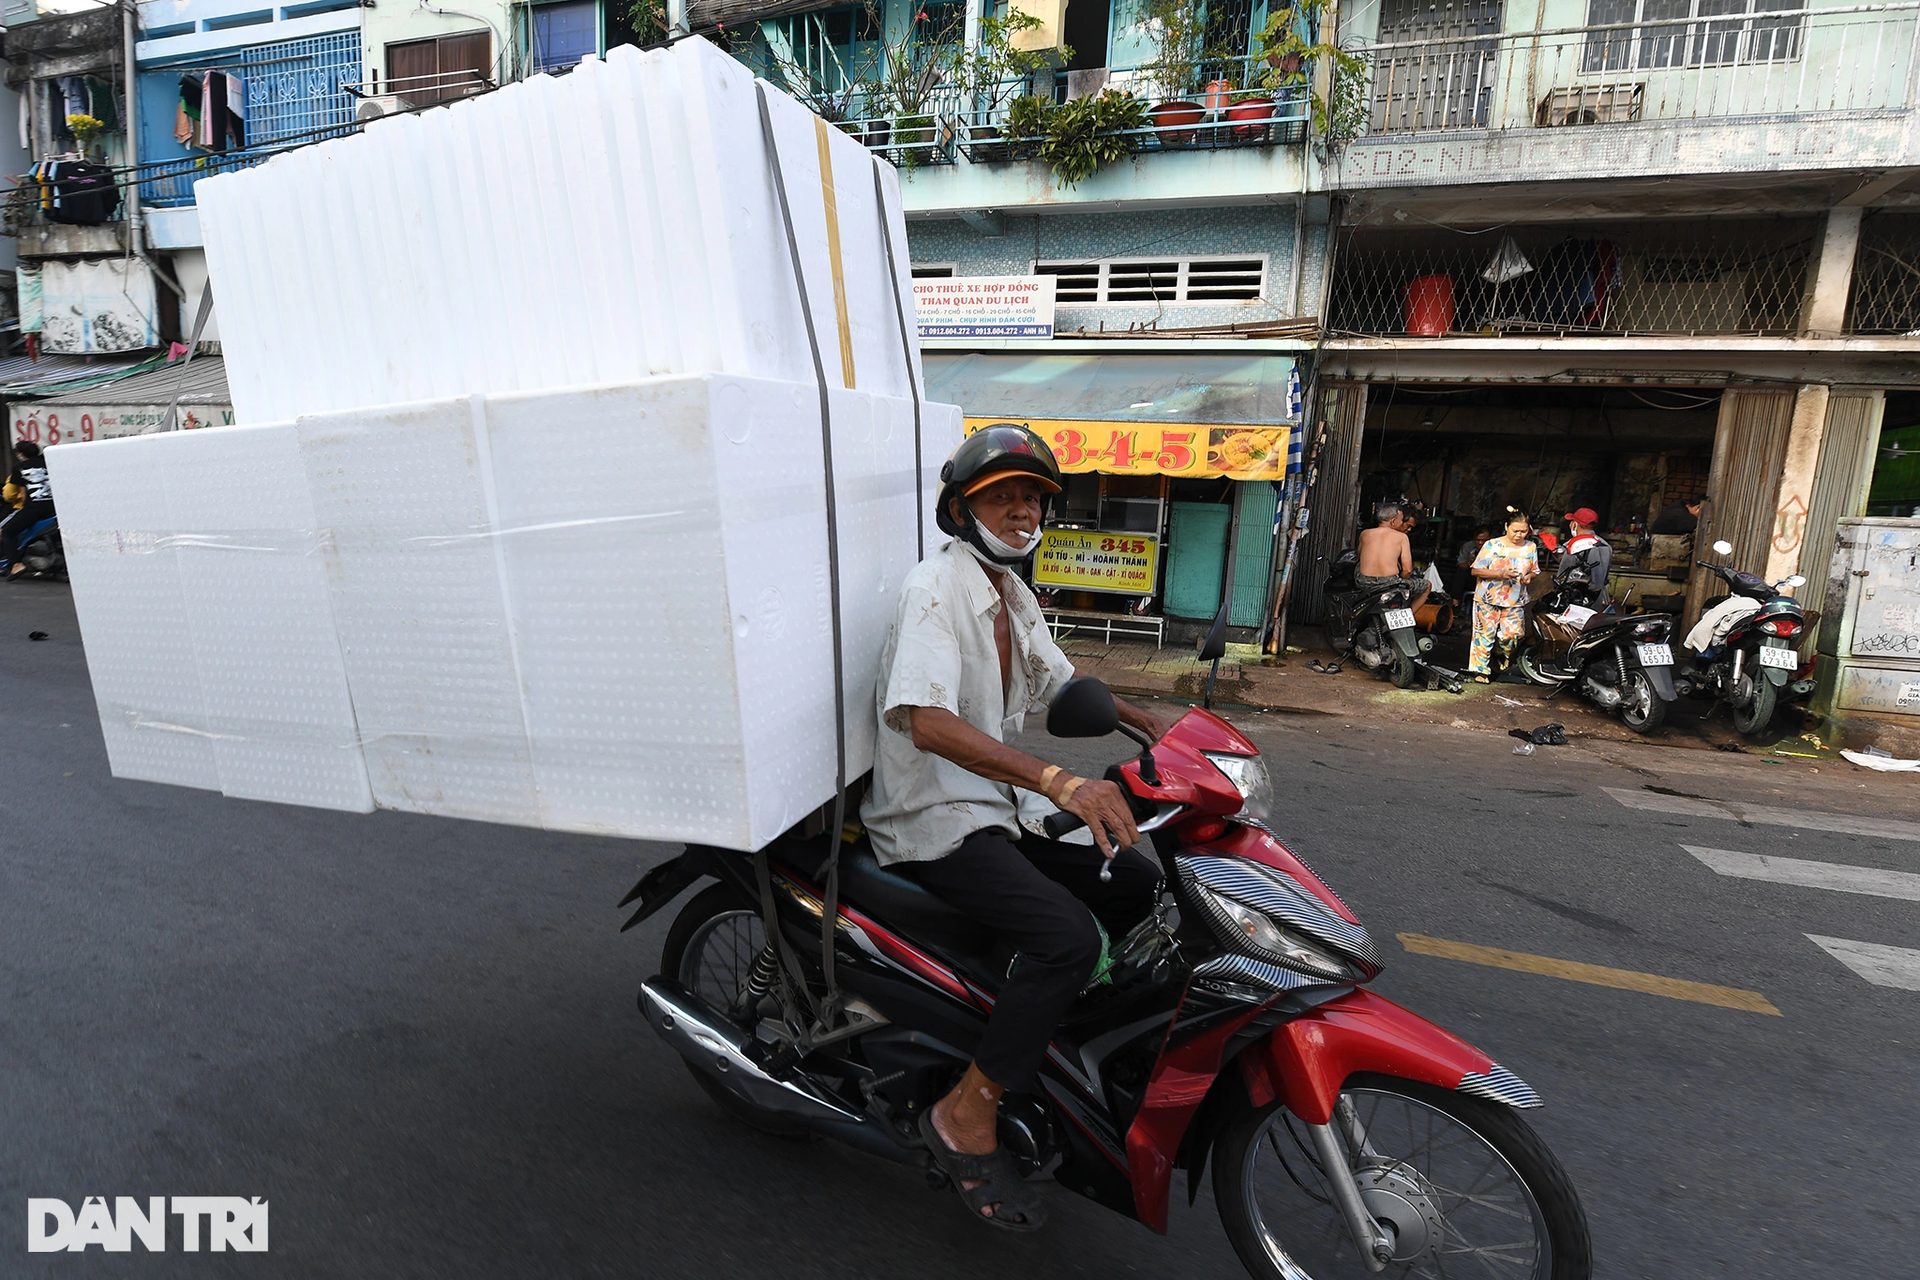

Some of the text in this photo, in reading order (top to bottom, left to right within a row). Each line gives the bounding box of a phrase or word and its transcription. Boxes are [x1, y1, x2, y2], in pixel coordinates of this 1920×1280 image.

[936, 283, 964, 293] THUÊ
[984, 283, 1005, 294] HỢP
[953, 297, 983, 306] QUAN
[1004, 296, 1029, 306] LỊCH
[1038, 326, 1047, 334] HÀ
[46, 414, 61, 445] 8
[81, 414, 94, 442] 9
[1052, 429, 1196, 470] 3-4-5
[1048, 536, 1146, 554] Quán Ăn 345
[1056, 550, 1067, 560] TÍU
[1076, 552, 1085, 562] MÌ
[1093, 553, 1119, 565] HOÀNH
[1122, 555, 1147, 566] THÁNH
[1076, 566, 1085, 575] TIM
[1090, 568, 1101, 576] GAN
[1766, 648, 1790, 659] 59-C1
[1762, 656, 1794, 668] 473.64
